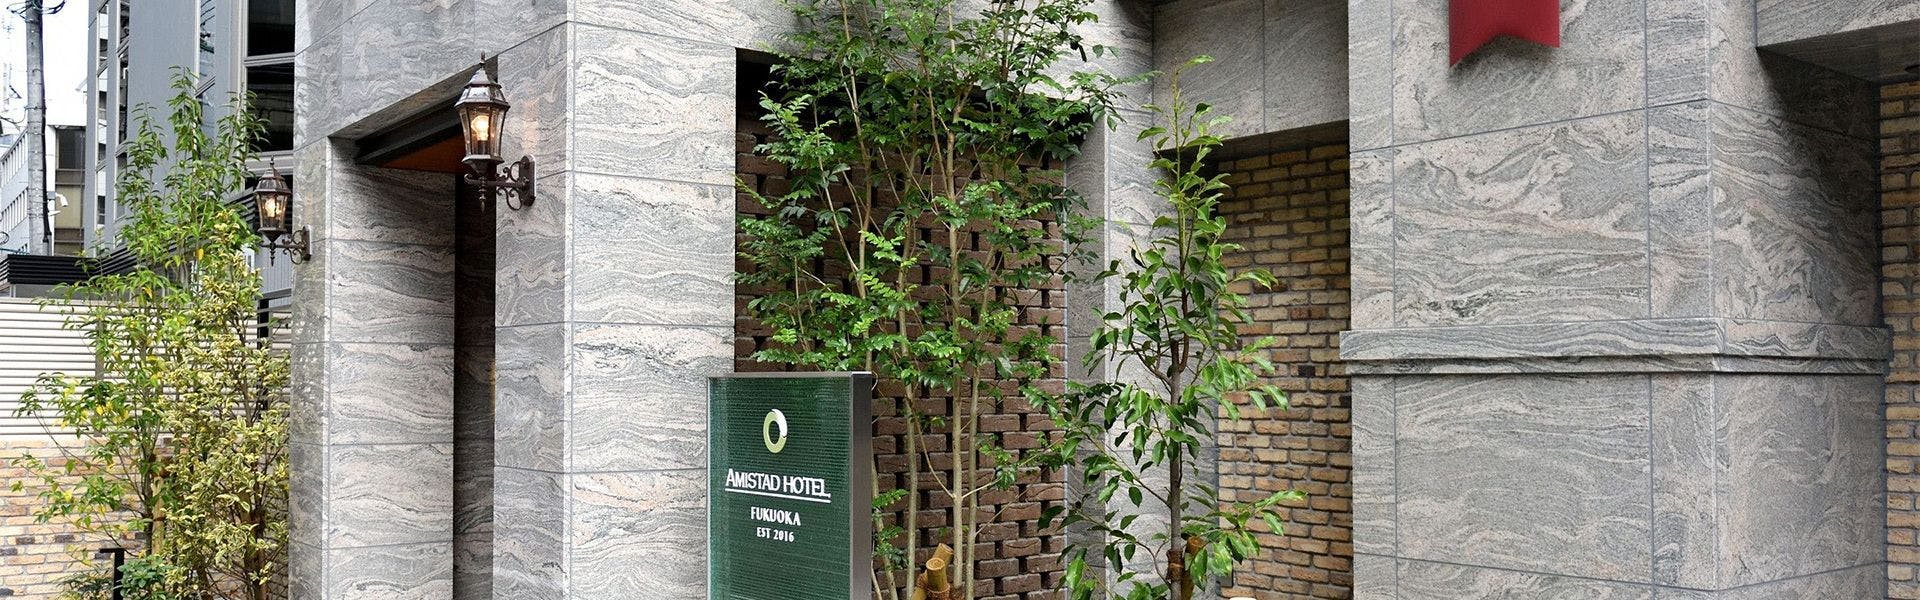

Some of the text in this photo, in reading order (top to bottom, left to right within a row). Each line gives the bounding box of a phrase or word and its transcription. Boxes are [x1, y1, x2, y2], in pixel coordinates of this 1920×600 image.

[725, 468, 831, 498] AMISTAD HOTEL
[751, 506, 801, 526] FUKUOKA
[756, 527, 795, 542] EST 2016
